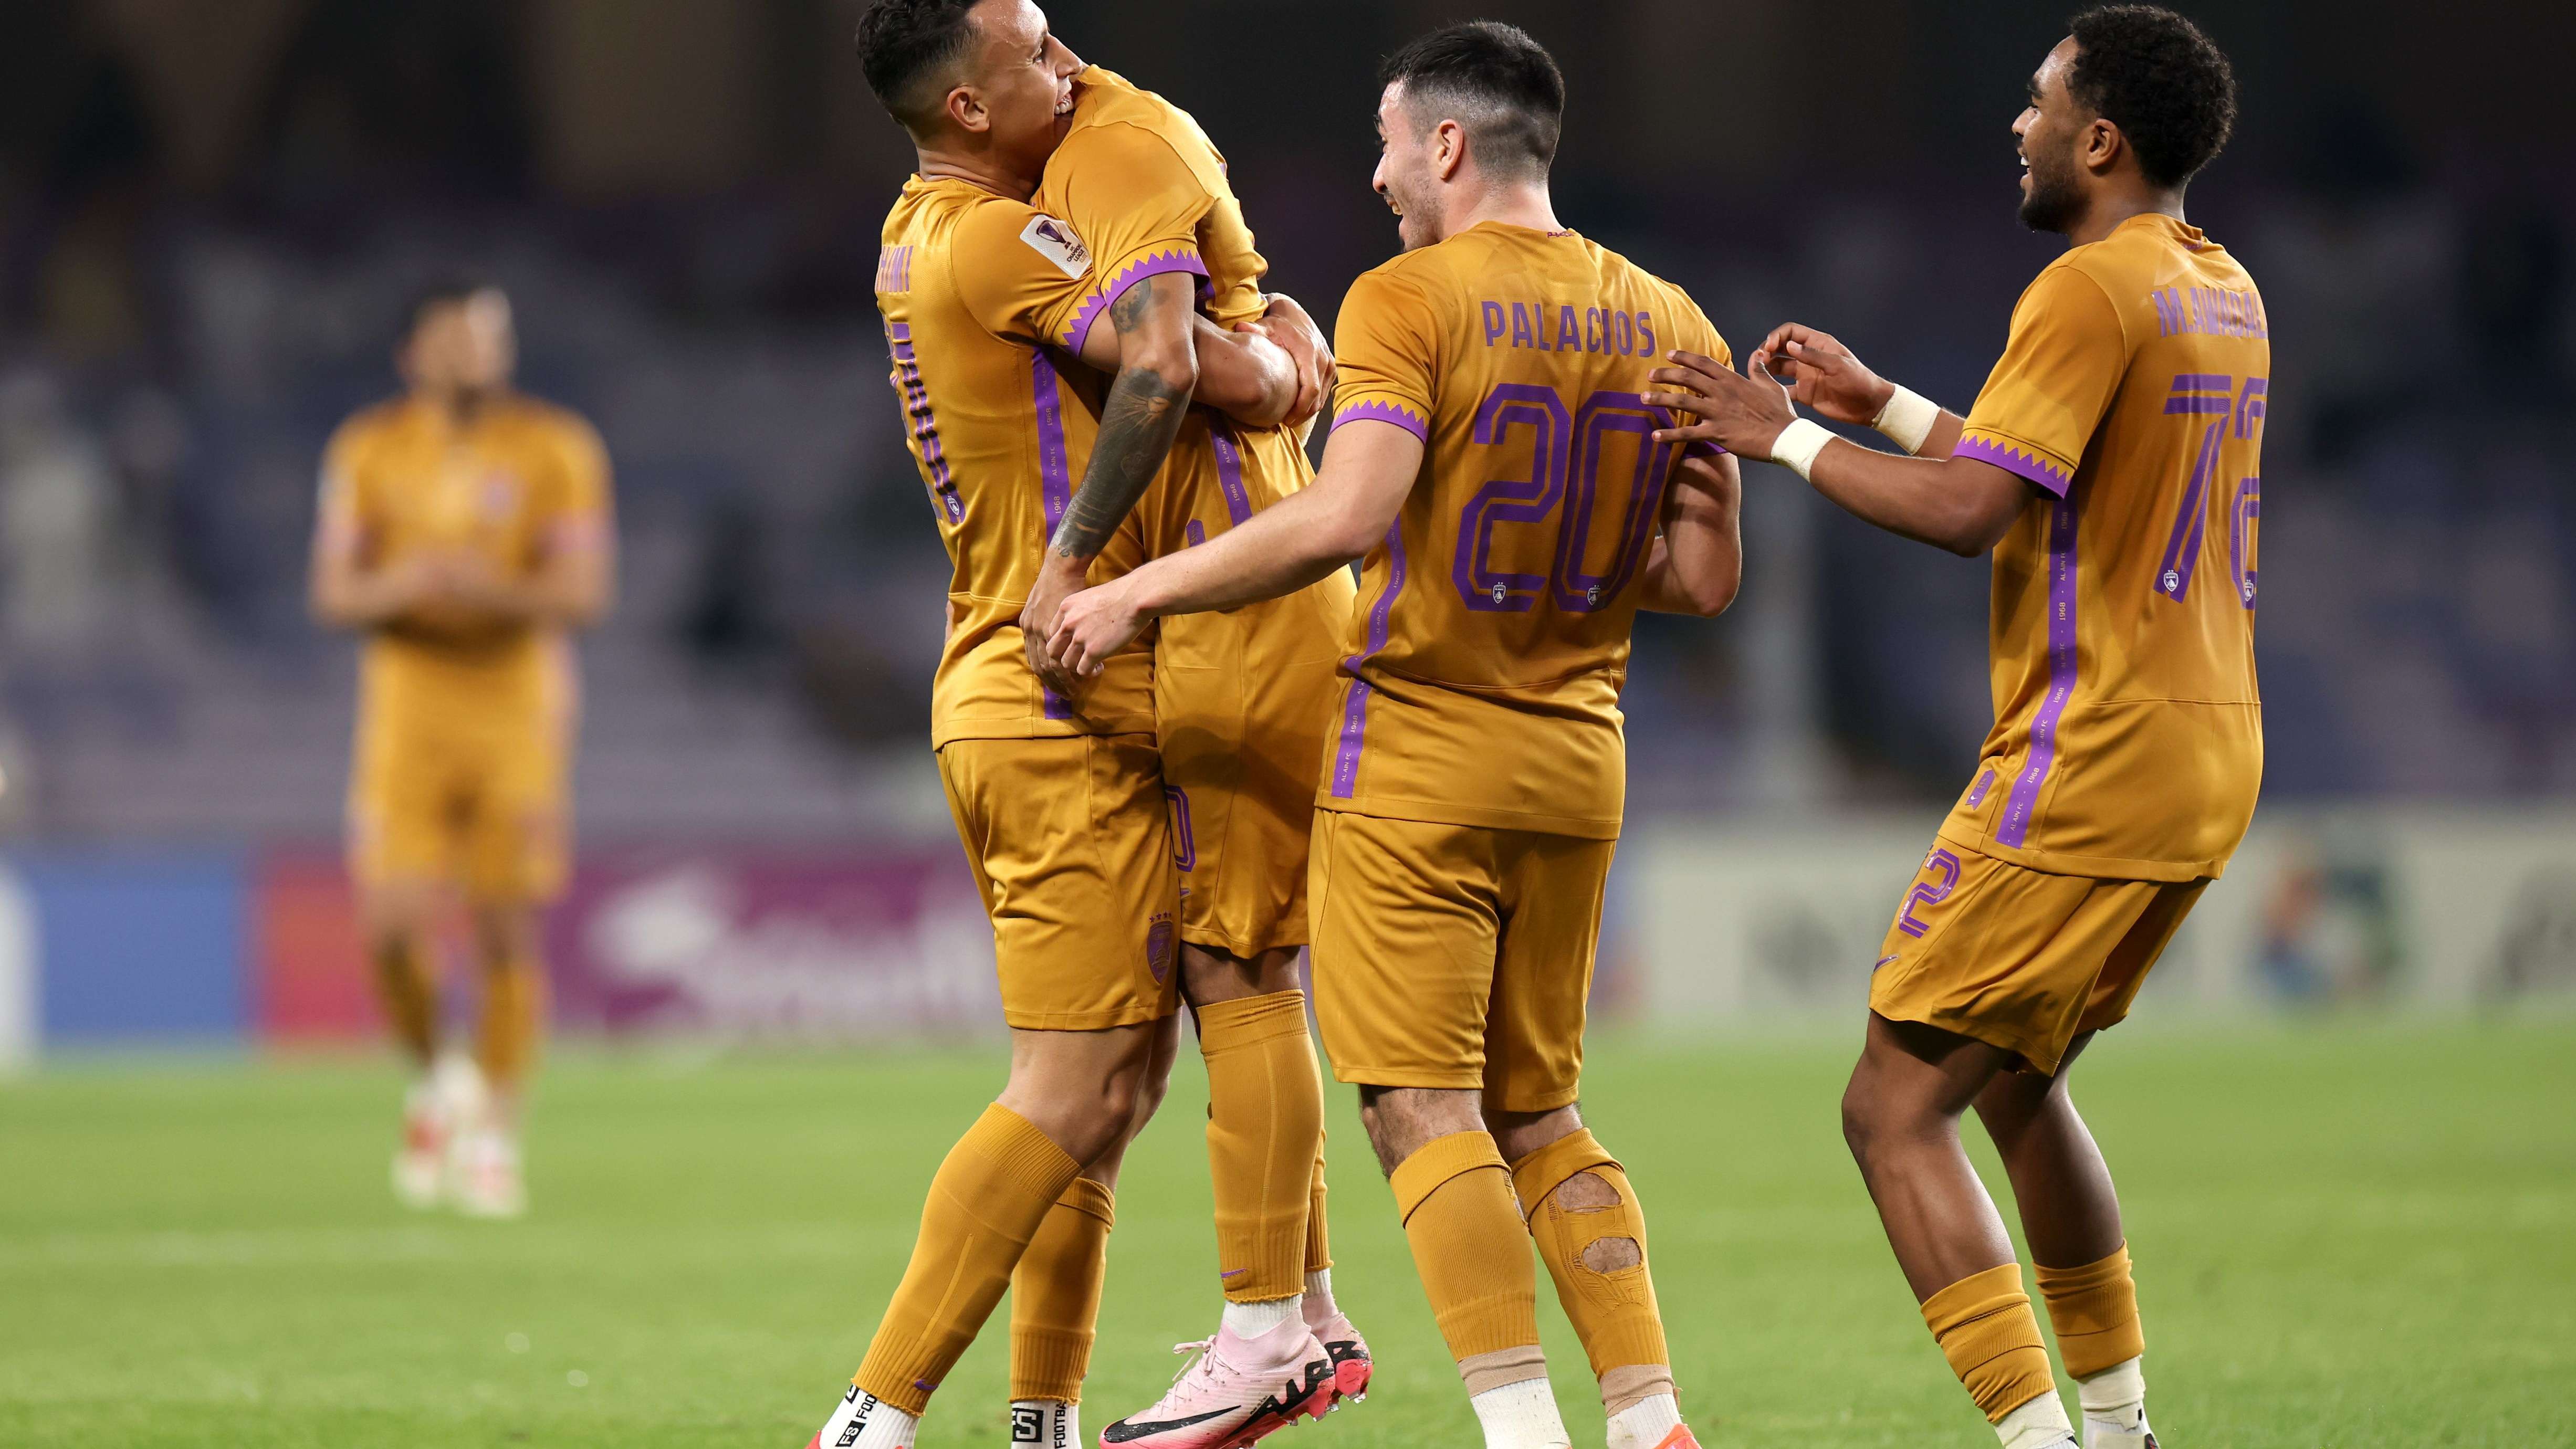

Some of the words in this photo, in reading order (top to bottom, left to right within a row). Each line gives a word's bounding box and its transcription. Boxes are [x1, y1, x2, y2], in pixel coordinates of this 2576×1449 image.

[1481, 301, 1656, 358] PALACIOS
[1230, 484, 1240, 501] 1968
[1452, 383, 1676, 612] 20
[2027, 767, 2040, 784] 1968
[2060, 573, 2066, 581] AL
[1342, 774, 1347, 782] AL
[1345, 751, 1352, 760] FC
[2010, 823, 2016, 832] AL
[2017, 802, 2024, 810] FC
[1899, 848, 1961, 939] 2
